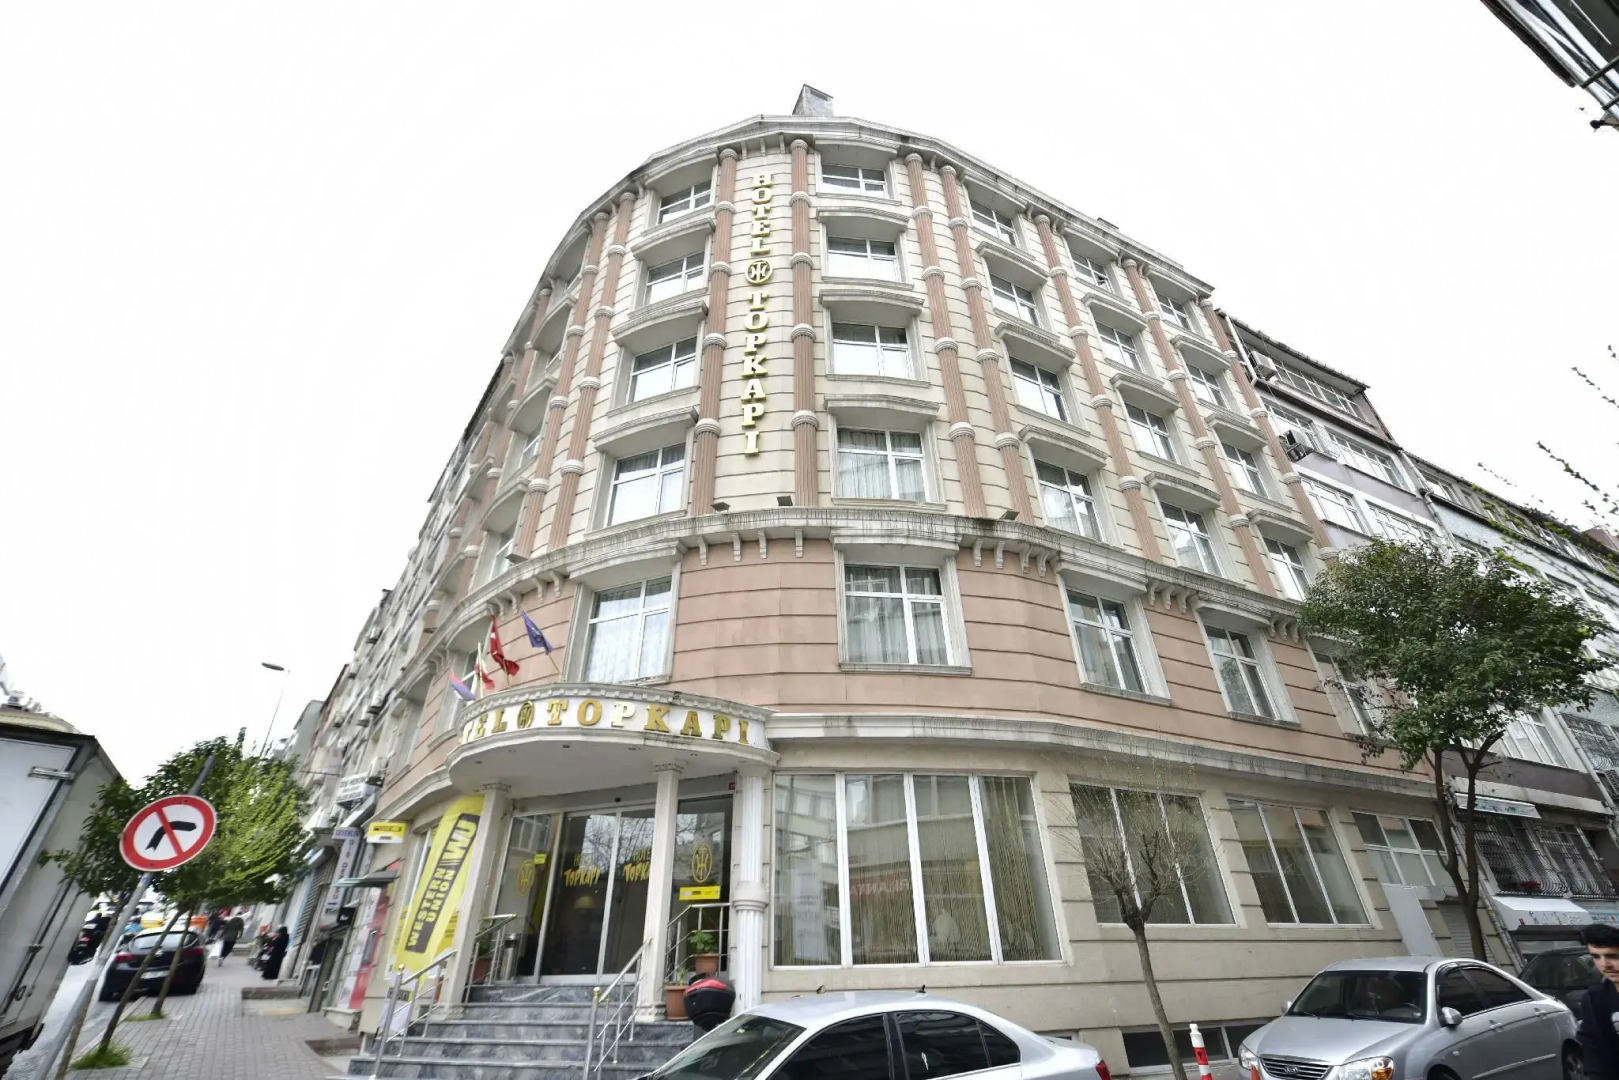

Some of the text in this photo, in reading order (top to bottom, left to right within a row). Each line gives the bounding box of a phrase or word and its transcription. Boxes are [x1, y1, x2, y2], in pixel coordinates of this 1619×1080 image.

[741, 174, 773, 457] HOTEL TOPKAPI
[458, 698, 749, 745] TEL TOPKAPI
[442, 819, 478, 861] WU
[632, 847, 651, 863] HOTE
[622, 860, 651, 883] TOPK
[408, 867, 446, 947] WESTERN
[426, 869, 456, 923] UNION
